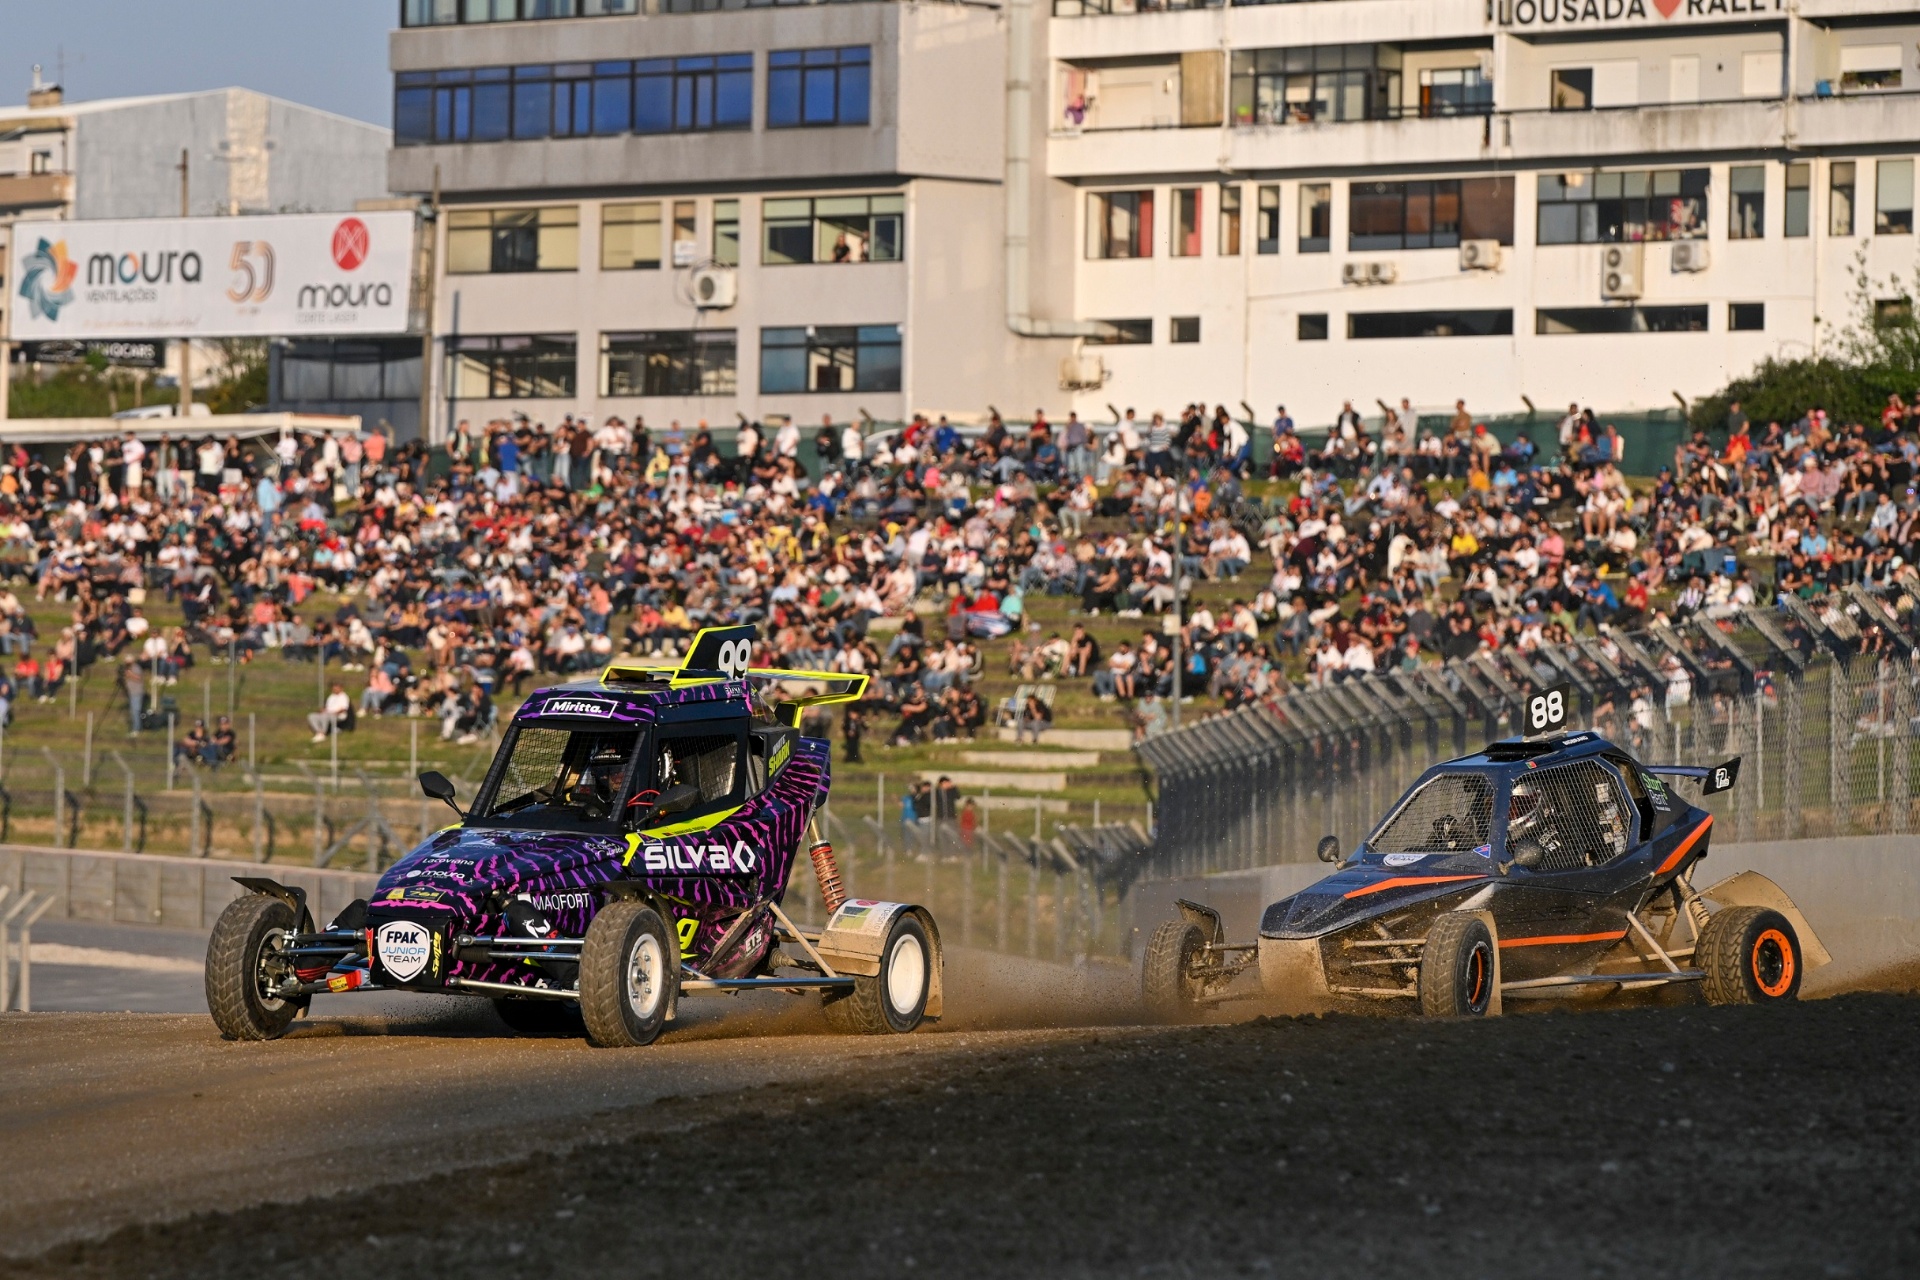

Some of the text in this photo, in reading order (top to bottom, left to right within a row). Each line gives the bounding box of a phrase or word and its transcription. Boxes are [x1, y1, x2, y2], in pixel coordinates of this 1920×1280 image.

[1498, 0, 1646, 25] LOUSADA
[87, 251, 202, 285] moura
[226, 240, 276, 304] 50
[297, 283, 392, 308] moura
[718, 638, 752, 681] 99
[1531, 690, 1564, 729] 88
[768, 739, 790, 778] SHARK
[420, 870, 465, 880] moura
[532, 892, 590, 912] MAQFORT
[386, 931, 420, 944] FPAK
[382, 946, 427, 955] JUNIOR
[387, 955, 421, 963] TEAM
